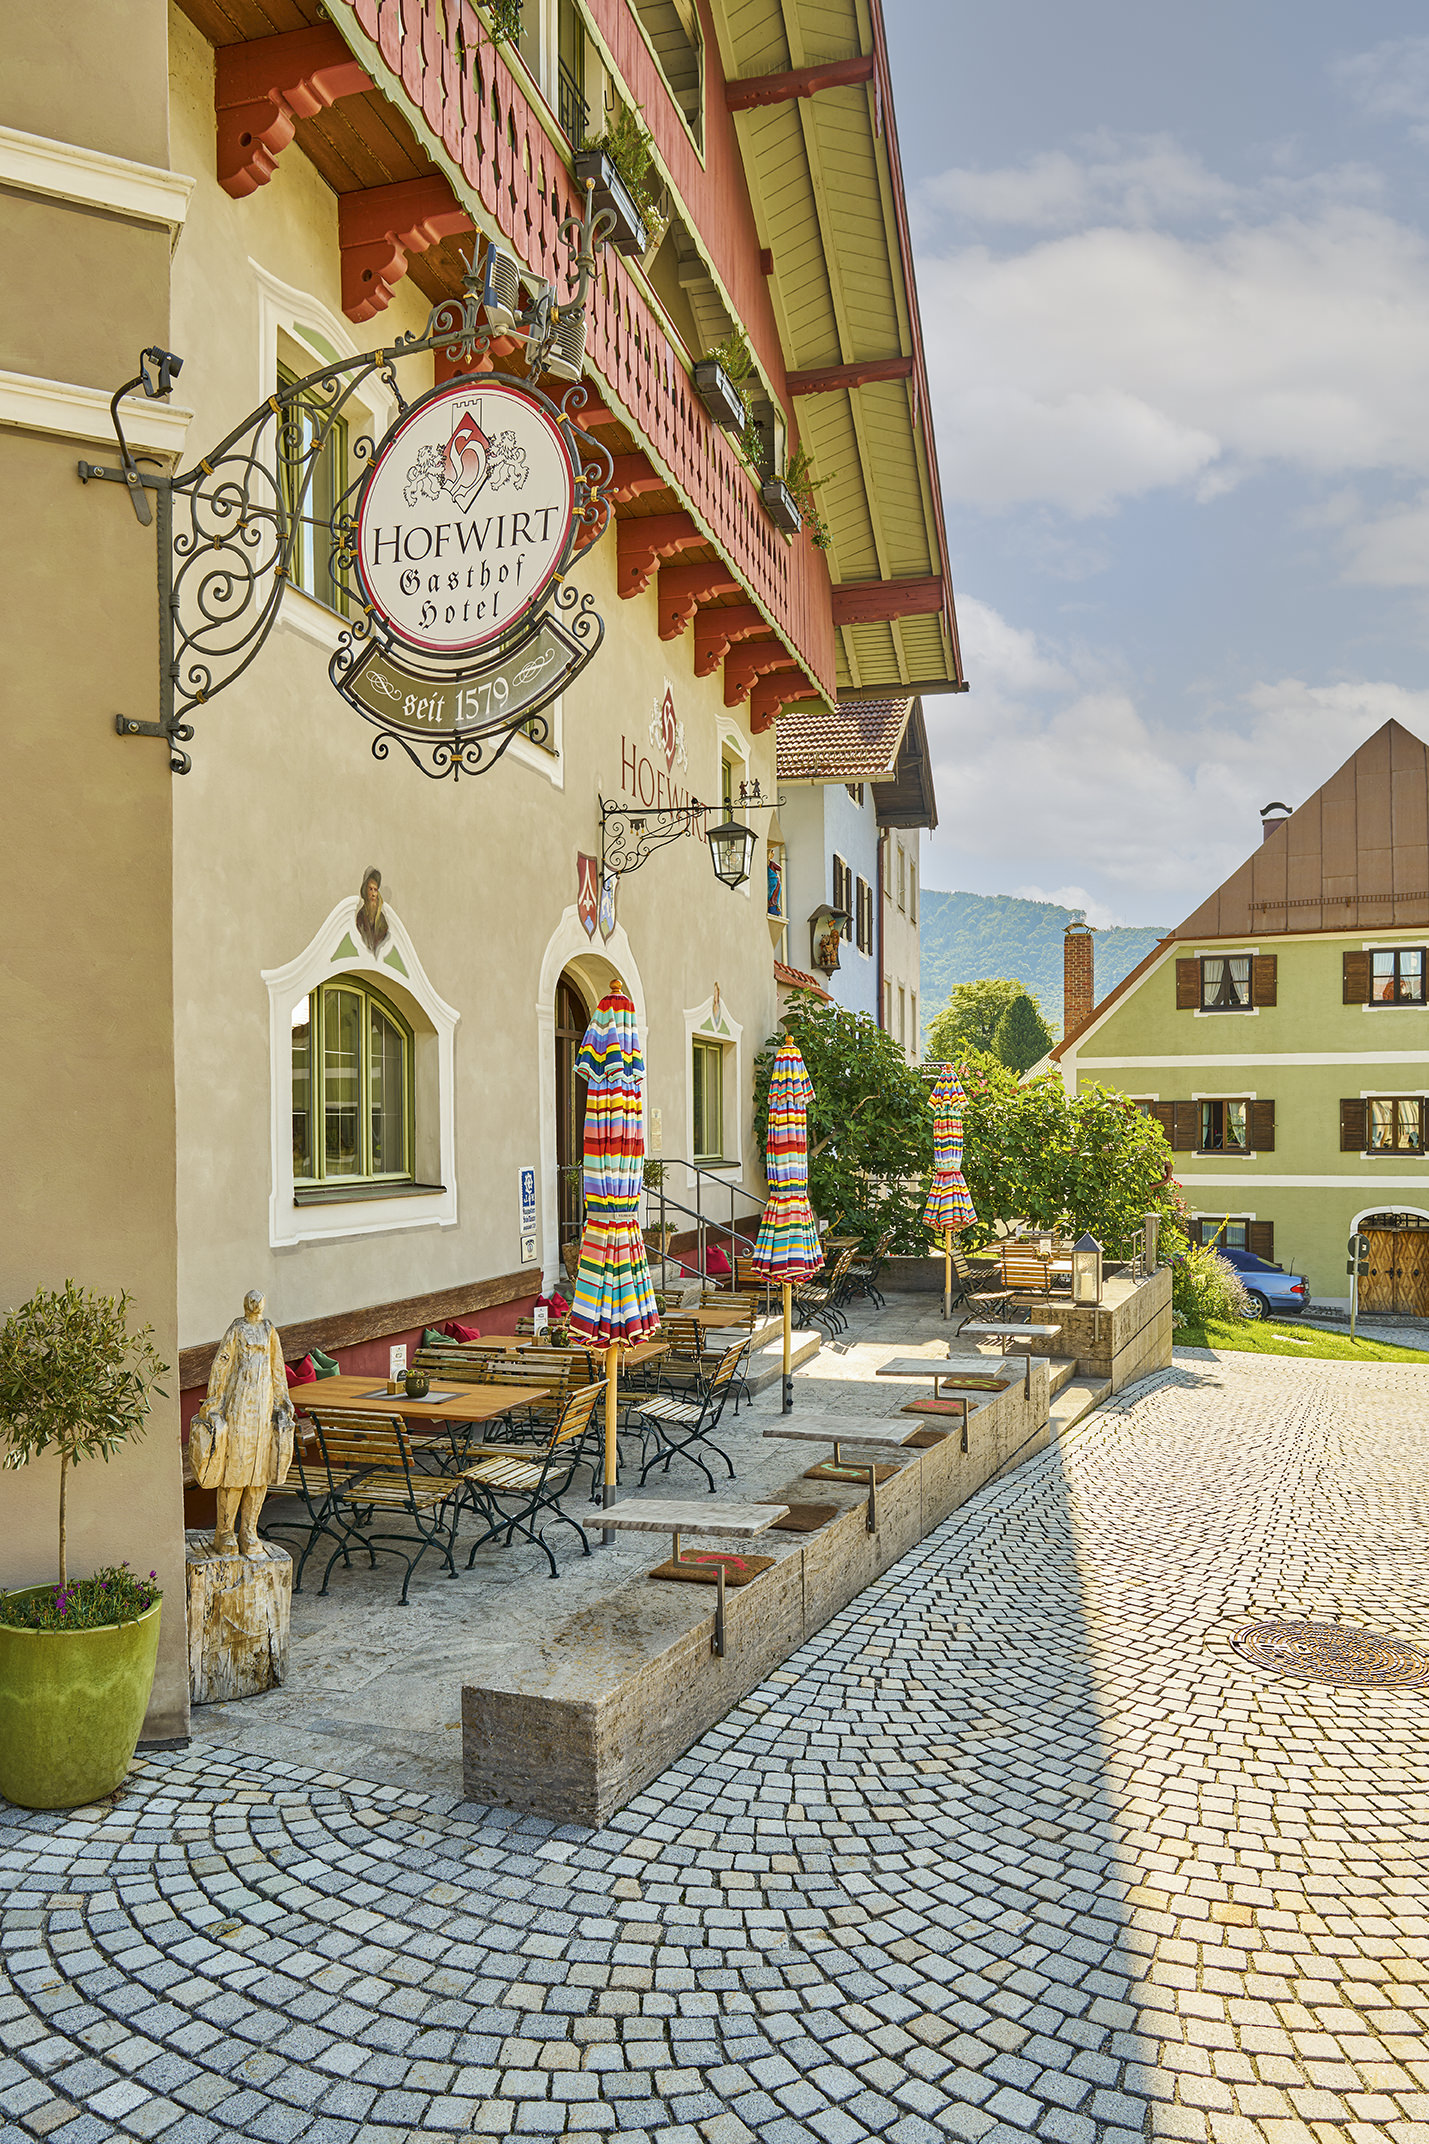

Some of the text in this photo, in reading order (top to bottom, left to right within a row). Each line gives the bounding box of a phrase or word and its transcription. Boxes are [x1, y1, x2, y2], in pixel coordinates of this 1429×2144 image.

[372, 505, 560, 566] HOFWIRT
[399, 552, 526, 596] Gasthof
[418, 590, 500, 629] Hotel
[402, 676, 509, 723] seit 1579
